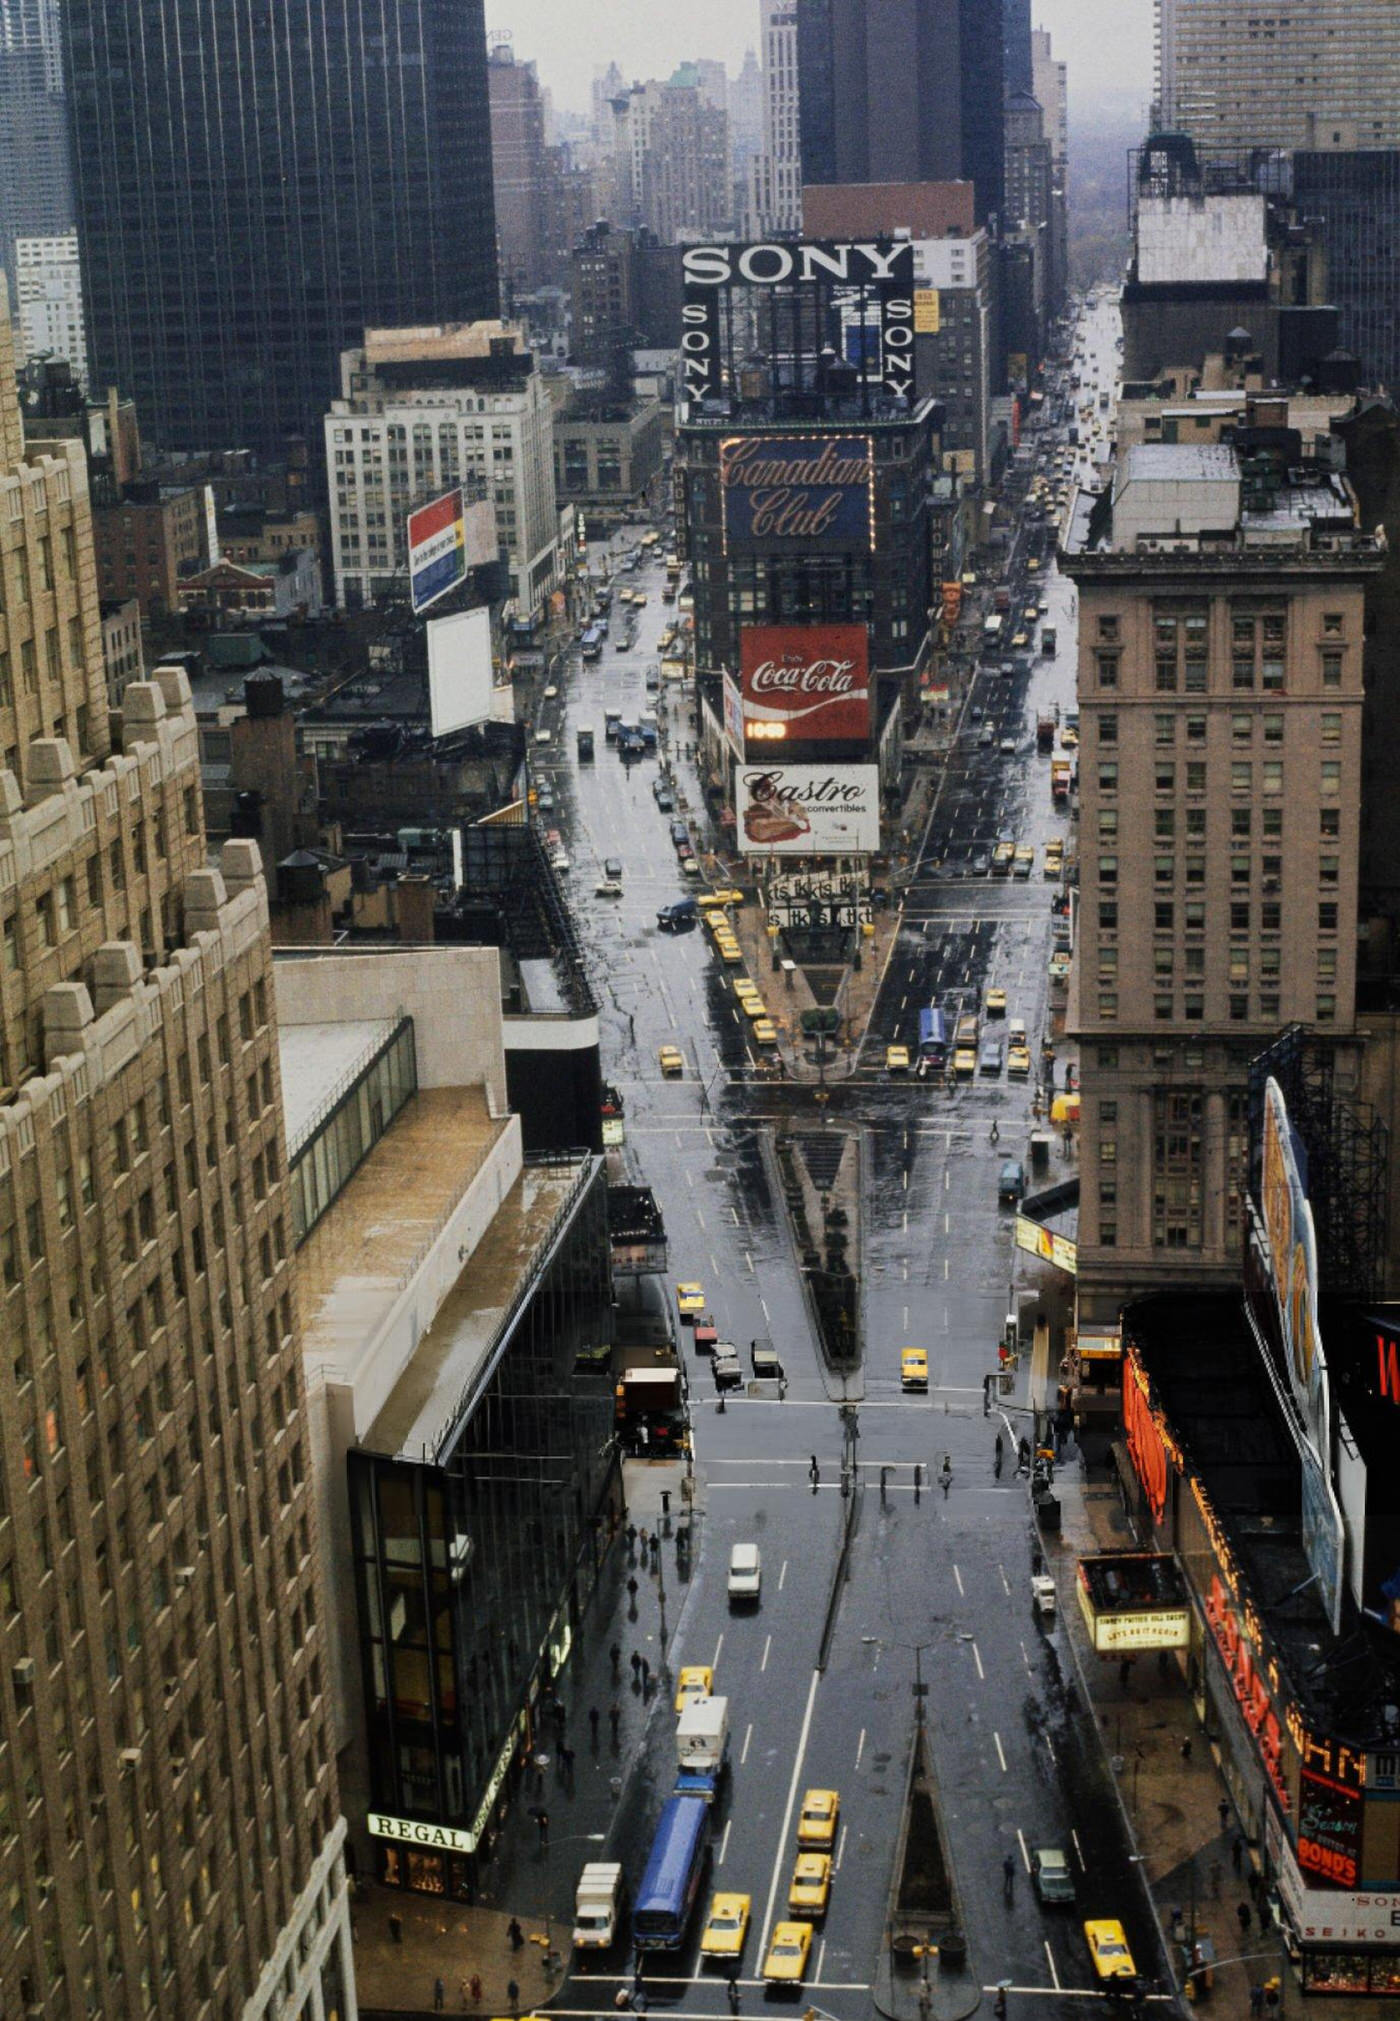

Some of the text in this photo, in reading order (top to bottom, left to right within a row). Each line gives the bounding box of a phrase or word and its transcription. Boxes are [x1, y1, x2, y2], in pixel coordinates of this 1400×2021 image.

[682, 244, 912, 284] SONY
[682, 304, 710, 402] SONY
[884, 299, 914, 398] SONY
[722, 437, 871, 487] Canadian
[749, 487, 844, 537] Club
[751, 660, 856, 692] Coca-Cola
[743, 770, 866, 803] Castro
[806, 803, 867, 813] convertibles
[376, 1817, 464, 1849] REGAL
[1305, 1926, 1386, 1938] SEIKO
